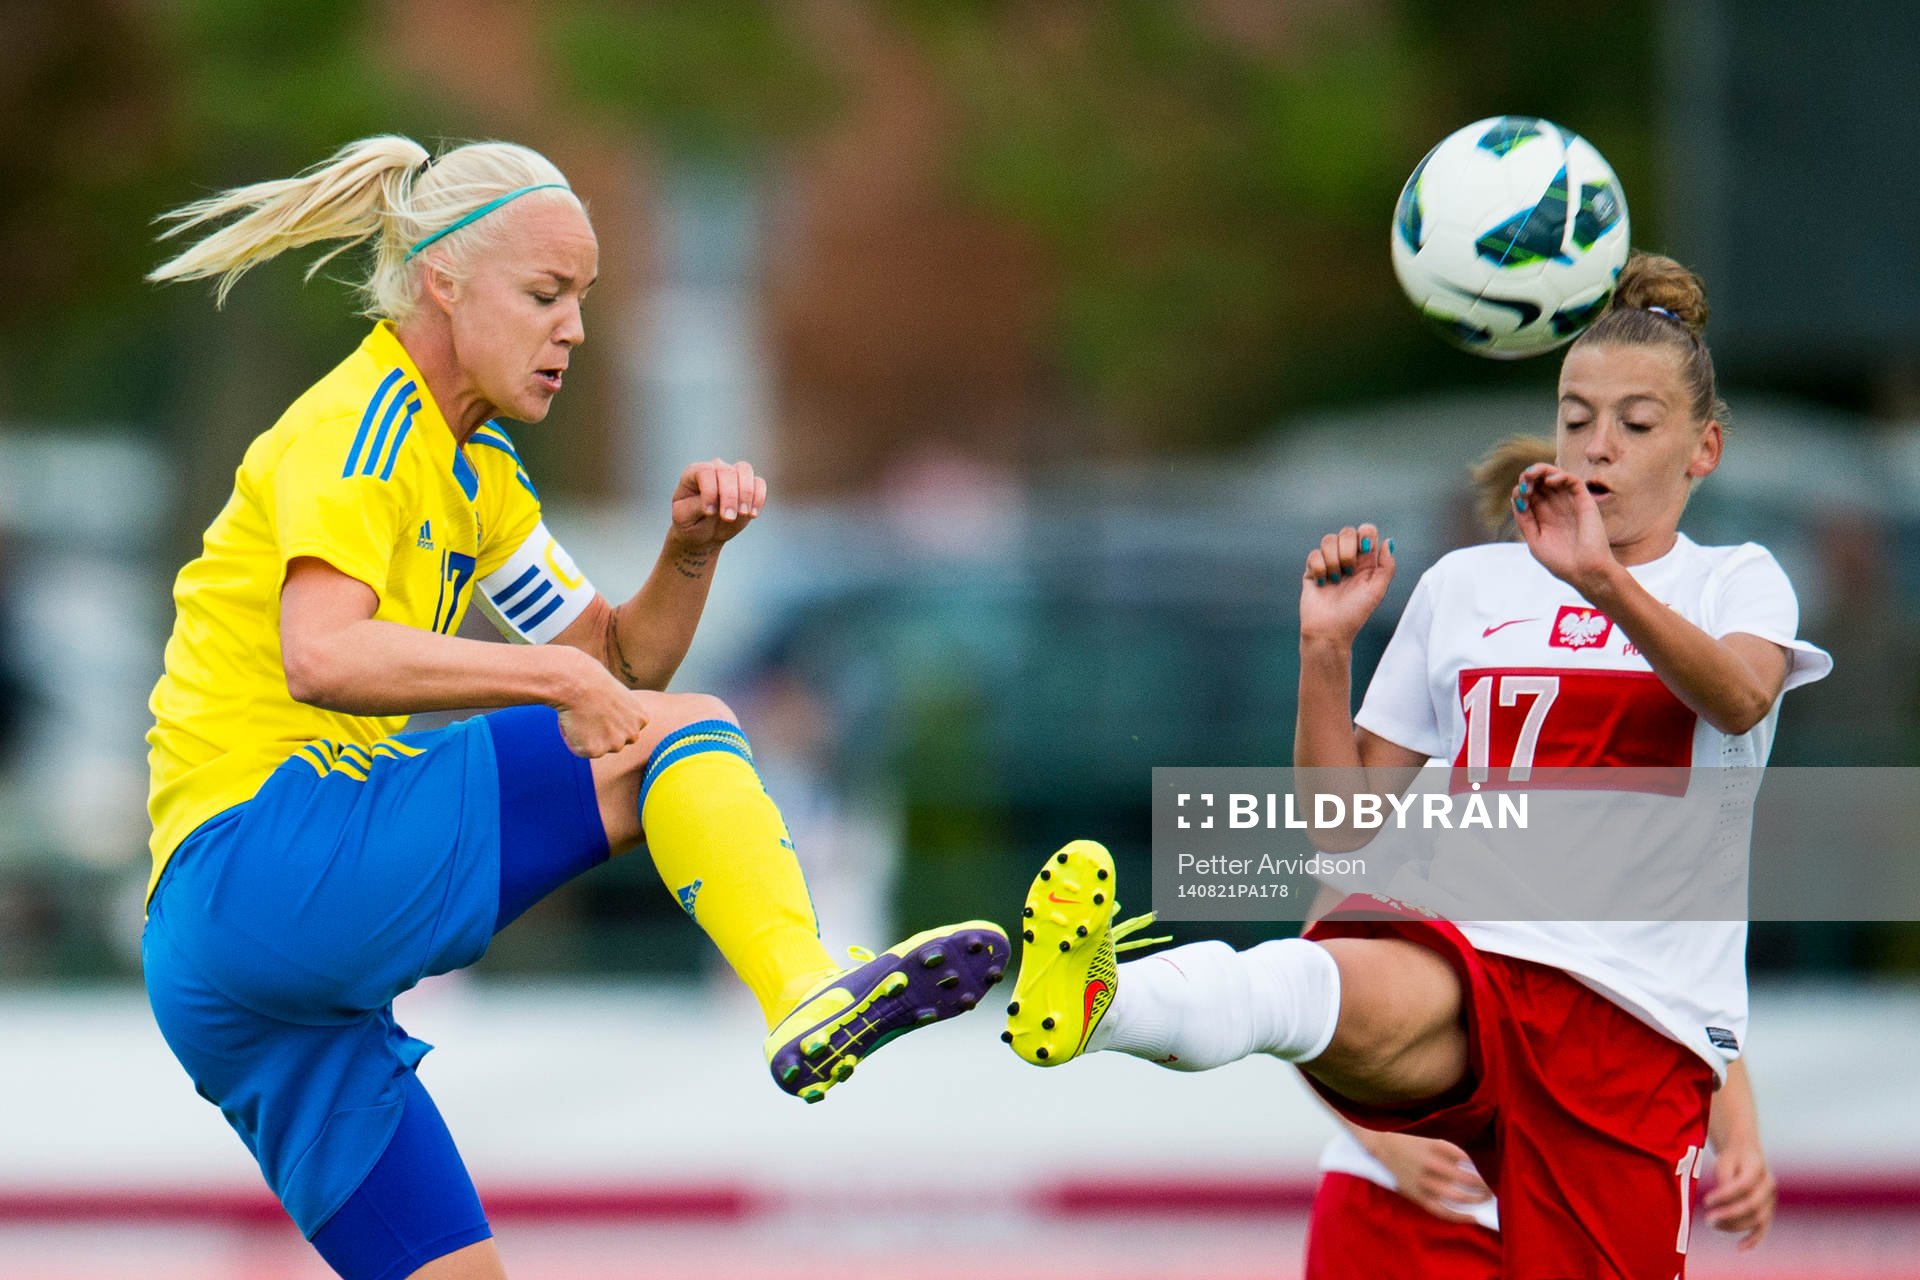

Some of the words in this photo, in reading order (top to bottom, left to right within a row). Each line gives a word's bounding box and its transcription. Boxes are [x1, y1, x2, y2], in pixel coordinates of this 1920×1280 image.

[431, 548, 476, 634] 17
[1463, 676, 1560, 783] 17
[1675, 1145, 1703, 1255] 1
